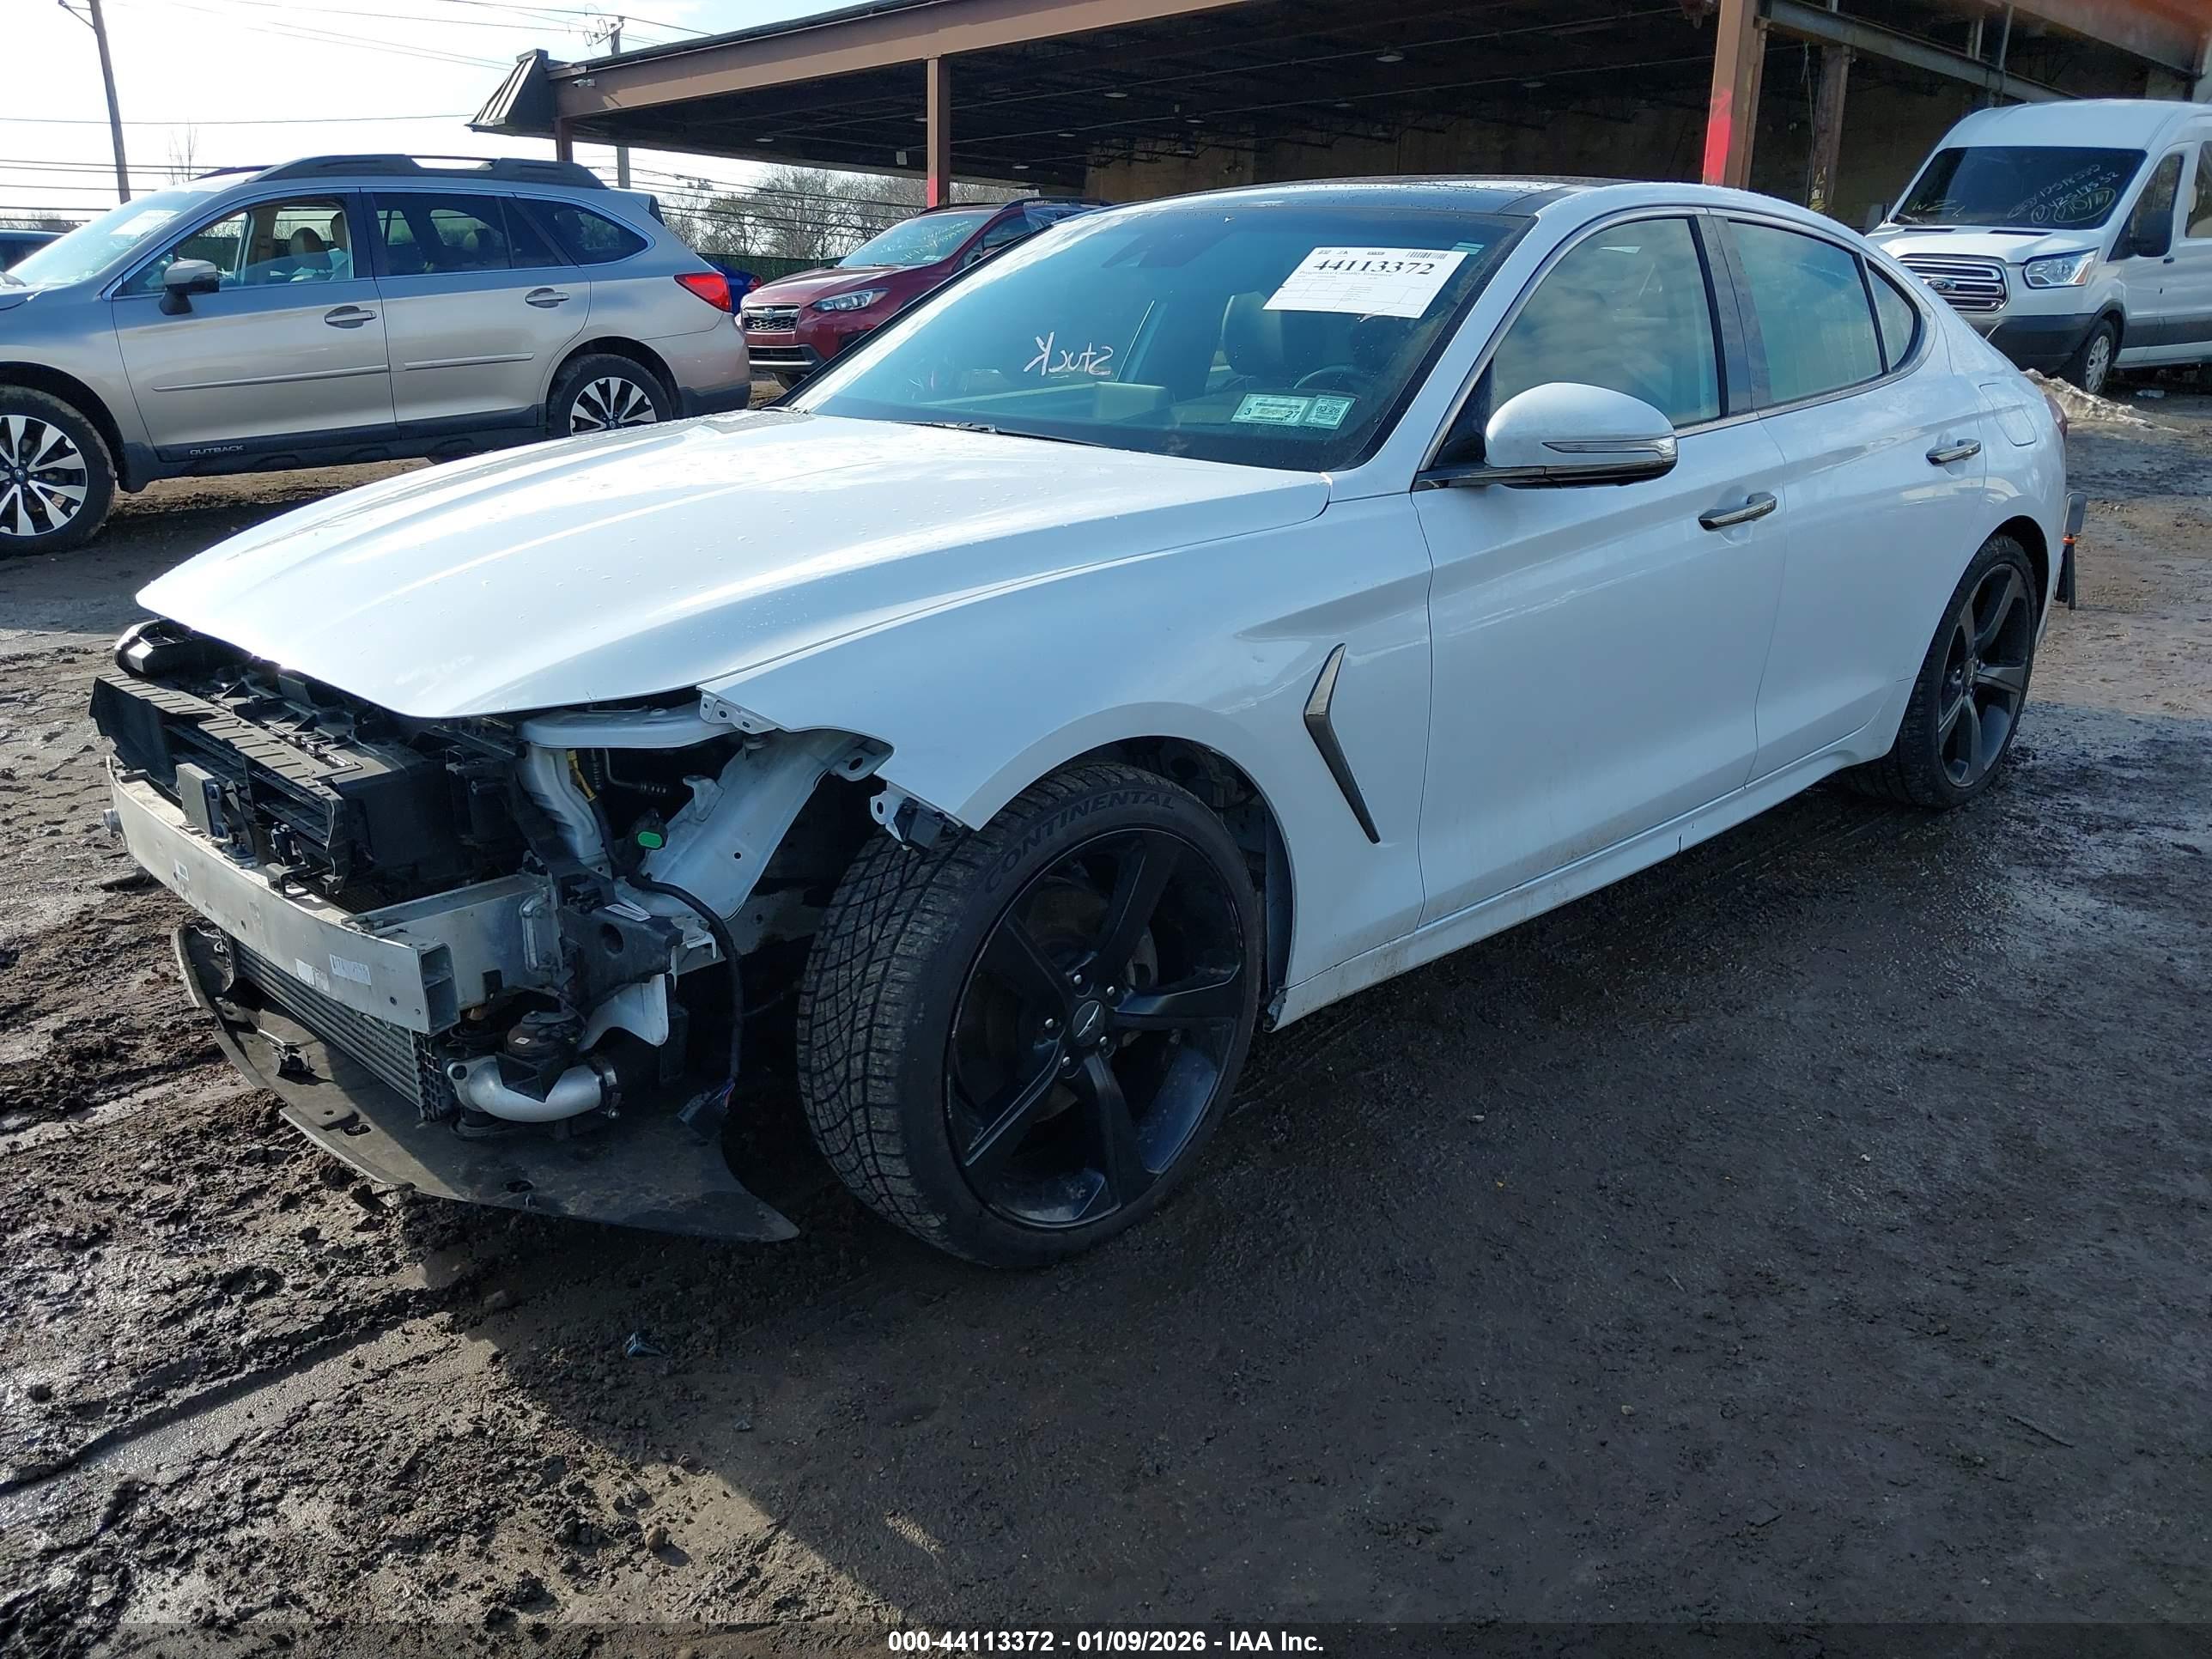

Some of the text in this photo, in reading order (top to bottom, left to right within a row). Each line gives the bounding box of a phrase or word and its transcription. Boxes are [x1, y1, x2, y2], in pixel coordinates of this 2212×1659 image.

[1313, 258, 1435, 276] 44113372
[1243, 407, 1253, 416] 3
[1284, 410, 1300, 419] 27
[189, 445, 244, 455] OUTBACK
[985, 790, 1176, 894] CONTINENTAL
